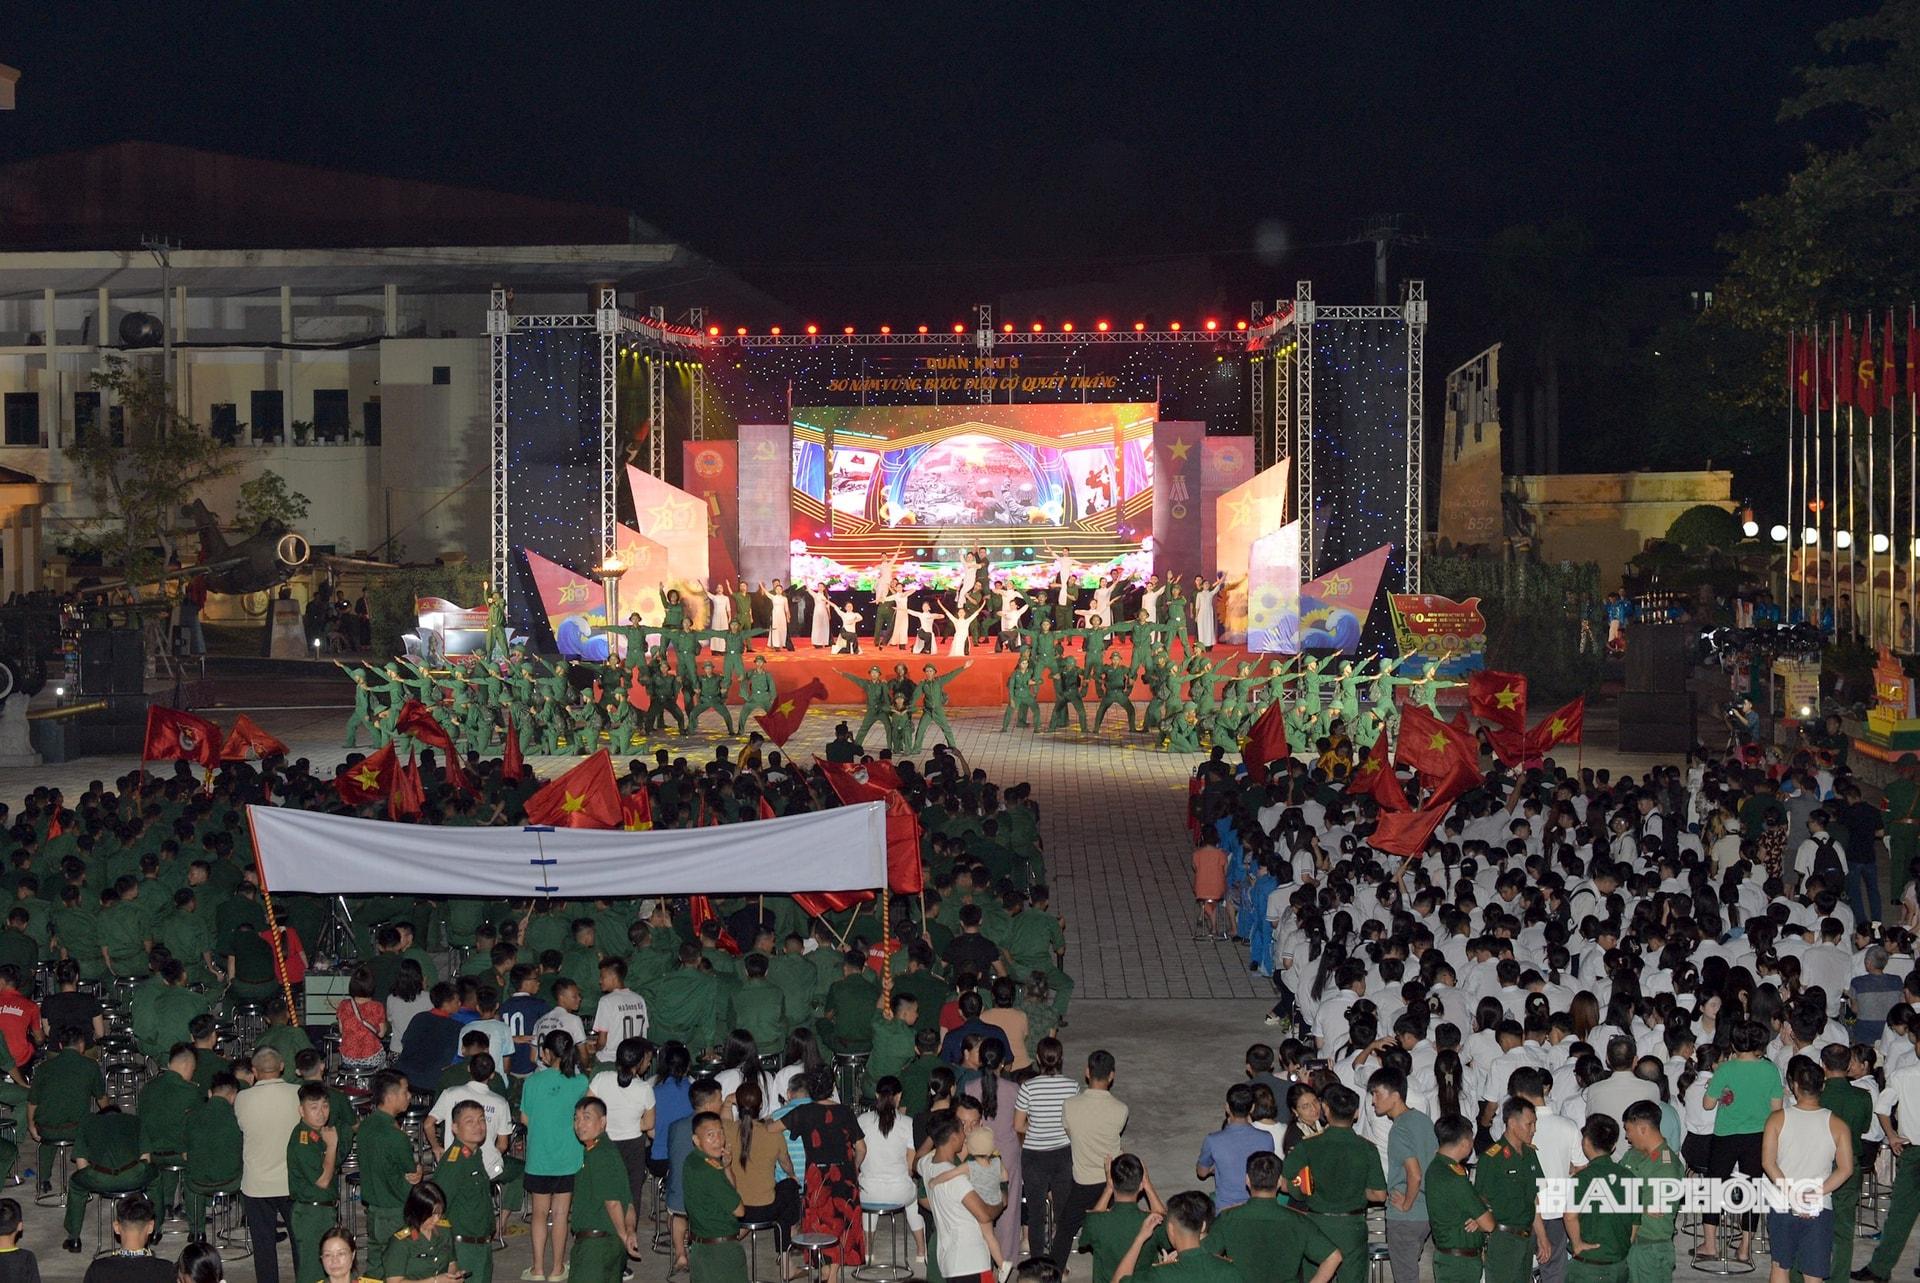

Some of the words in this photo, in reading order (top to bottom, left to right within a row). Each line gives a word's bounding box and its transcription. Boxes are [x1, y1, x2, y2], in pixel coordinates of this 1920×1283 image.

[926, 355, 968, 370] QUÂN
[974, 357, 1006, 370] KHU
[502, 1011, 525, 1036] 10
[622, 1015, 646, 1040] 07
